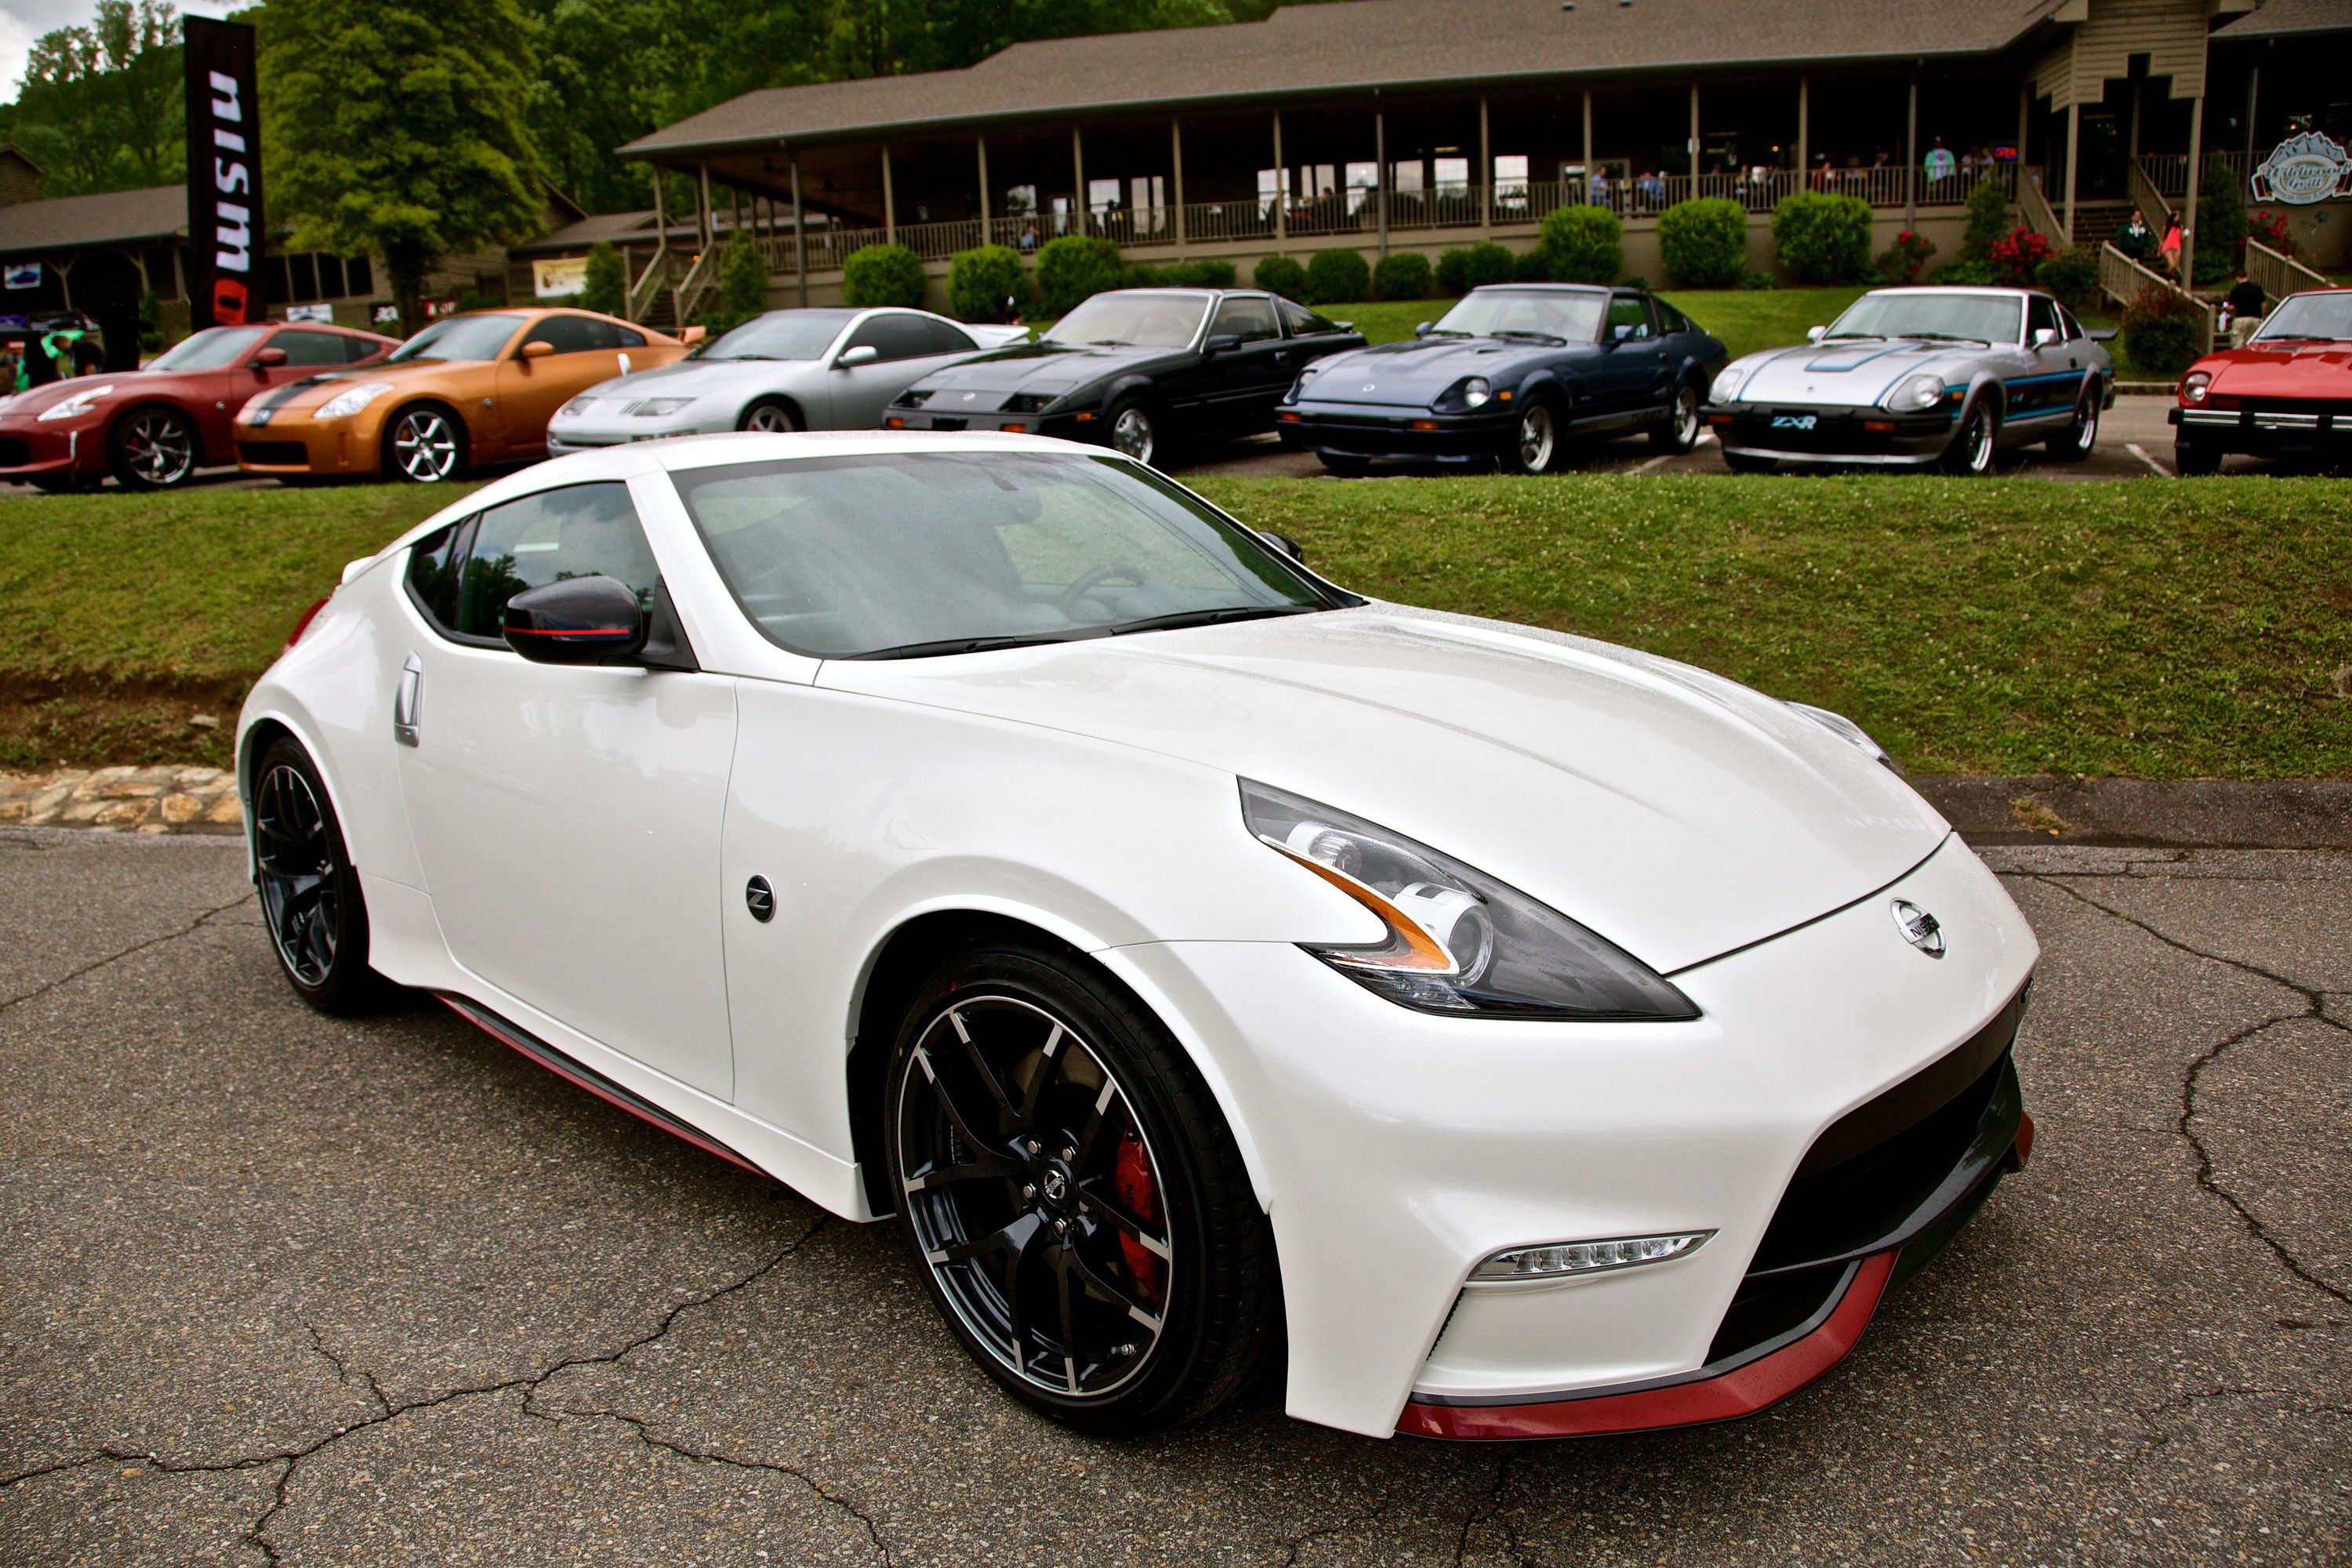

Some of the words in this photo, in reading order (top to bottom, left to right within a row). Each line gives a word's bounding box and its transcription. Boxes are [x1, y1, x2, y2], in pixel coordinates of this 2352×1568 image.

[209, 70, 251, 325] nismo
[1770, 415, 1817, 430] ZXR
[748, 887, 771, 910] Z
